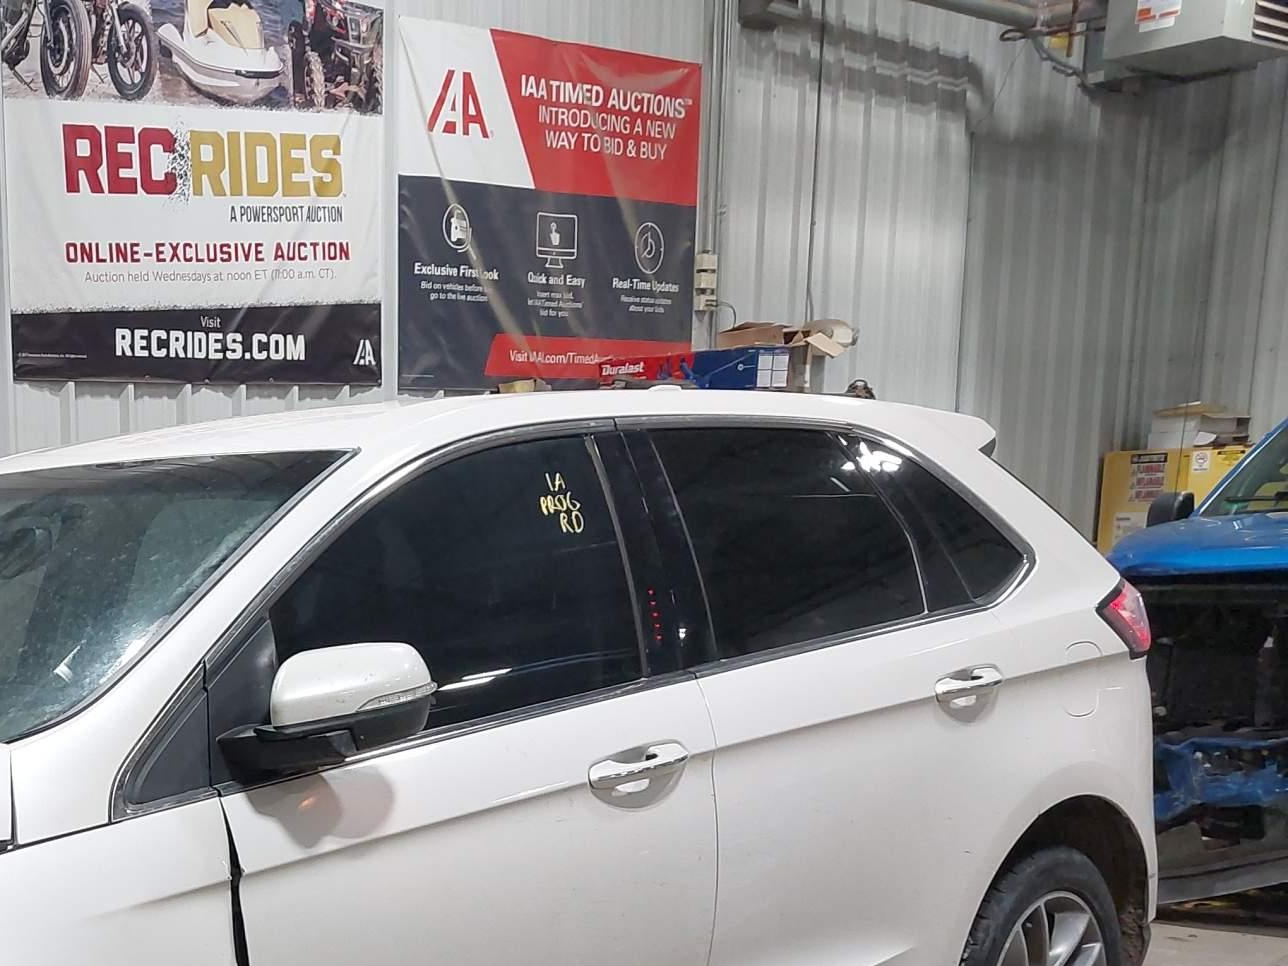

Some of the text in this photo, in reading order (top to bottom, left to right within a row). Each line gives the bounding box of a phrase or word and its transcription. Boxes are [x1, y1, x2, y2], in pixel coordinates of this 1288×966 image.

[520, 74, 547, 99] IAA
[549, 80, 604, 107] TIMED
[538, 105, 676, 139] INTRODUCING A NEW
[545, 130, 667, 160] WAY TO BID & BUY
[62, 124, 344, 198] REC RIDES
[230, 205, 343, 223] A POWERSPORT AUCTION
[65, 242, 350, 263] ONLINE-EXCLUSIVE AUCTION
[85, 271, 125, 283] Auction
[127, 270, 150, 282] held
[152, 270, 212, 284] Wednesdays
[213, 271, 223, 281] at
[226, 271, 252, 281] noon
[254, 269, 268, 280] ET
[414, 262, 458, 277] Exclusive
[527, 271, 586, 288] Quick and Easy
[612, 277, 680, 293] Real-Time Updates
[200, 315, 222, 328] Visit
[115, 328, 306, 361] RECRIDES.COM
[509, 350, 528, 362] Visit
[601, 361, 645, 376] Duralast
